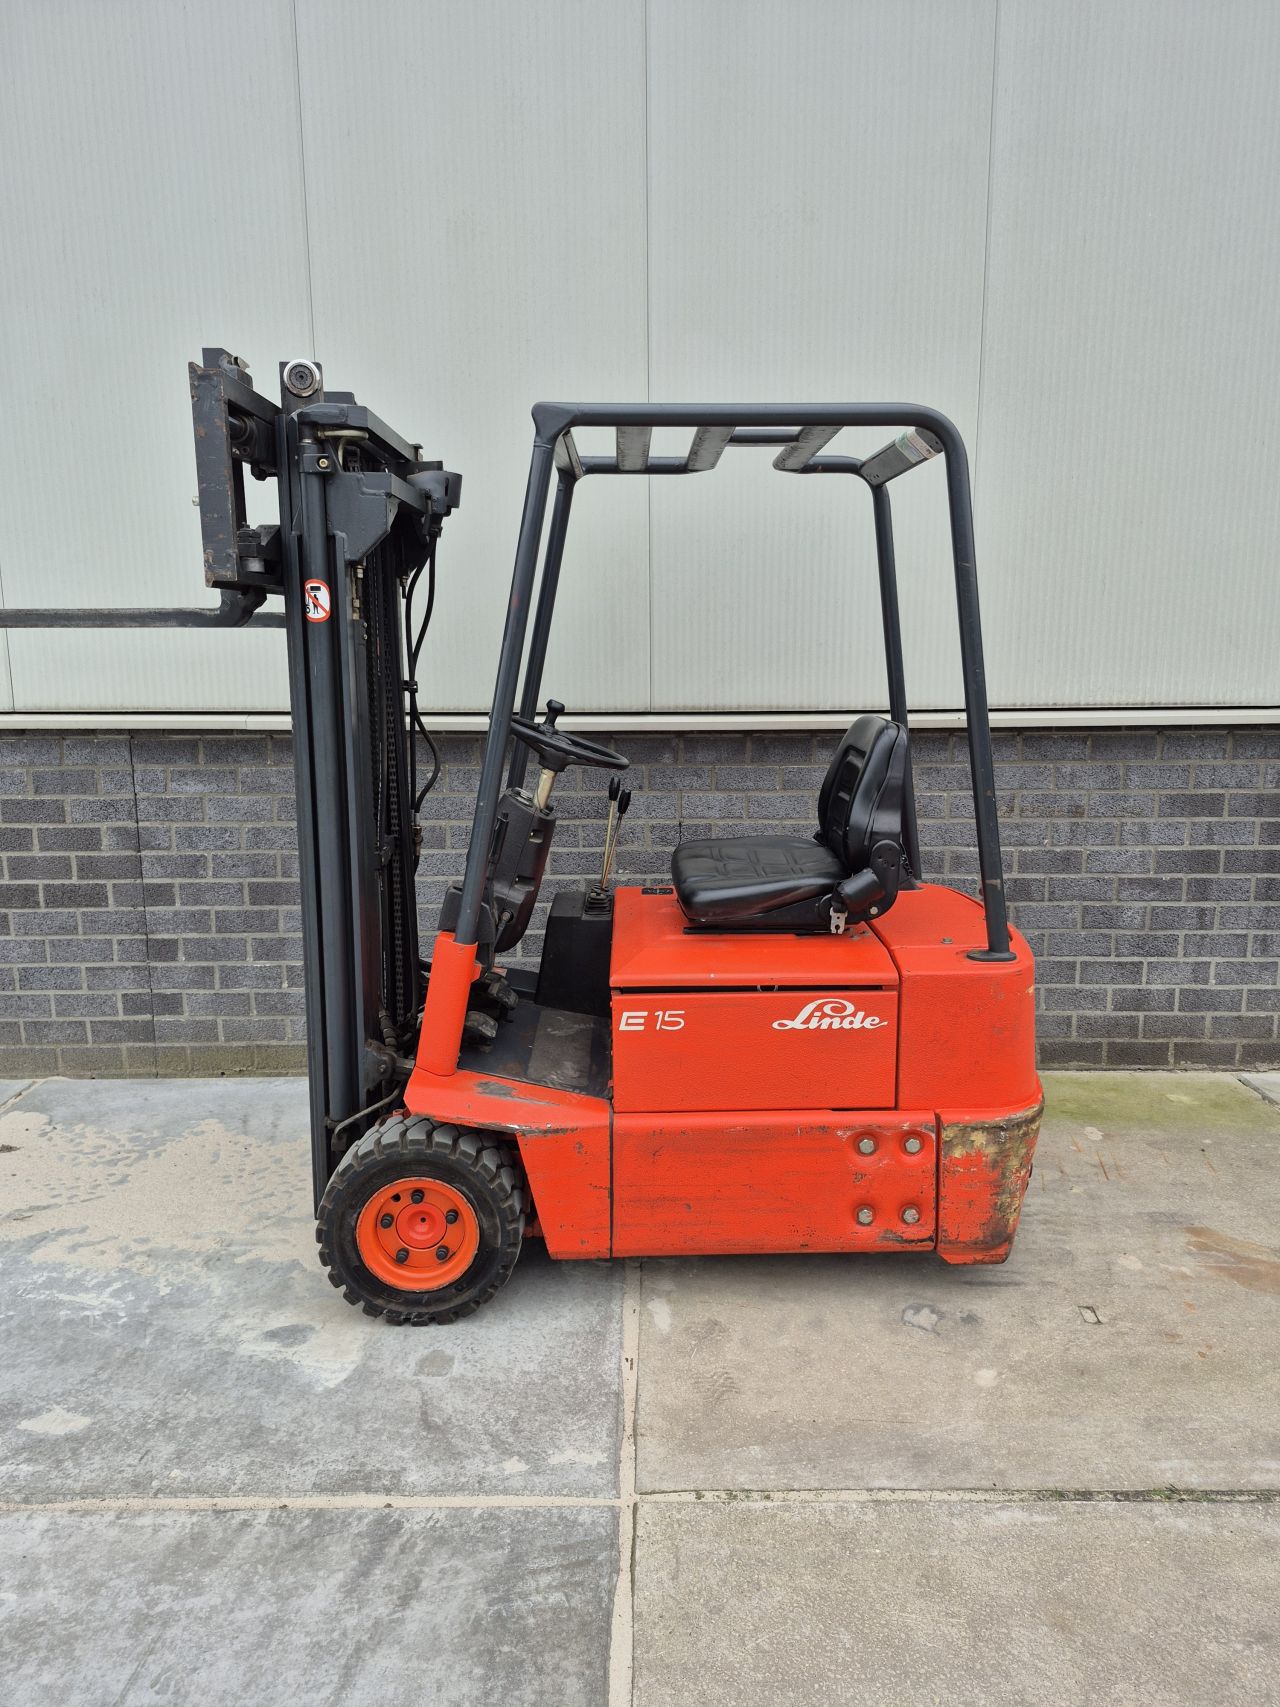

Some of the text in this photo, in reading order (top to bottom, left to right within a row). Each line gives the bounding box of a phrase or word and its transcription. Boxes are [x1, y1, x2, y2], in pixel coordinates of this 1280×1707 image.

[619, 1010, 686, 1031] E 15
[772, 998, 888, 1030] Linde
